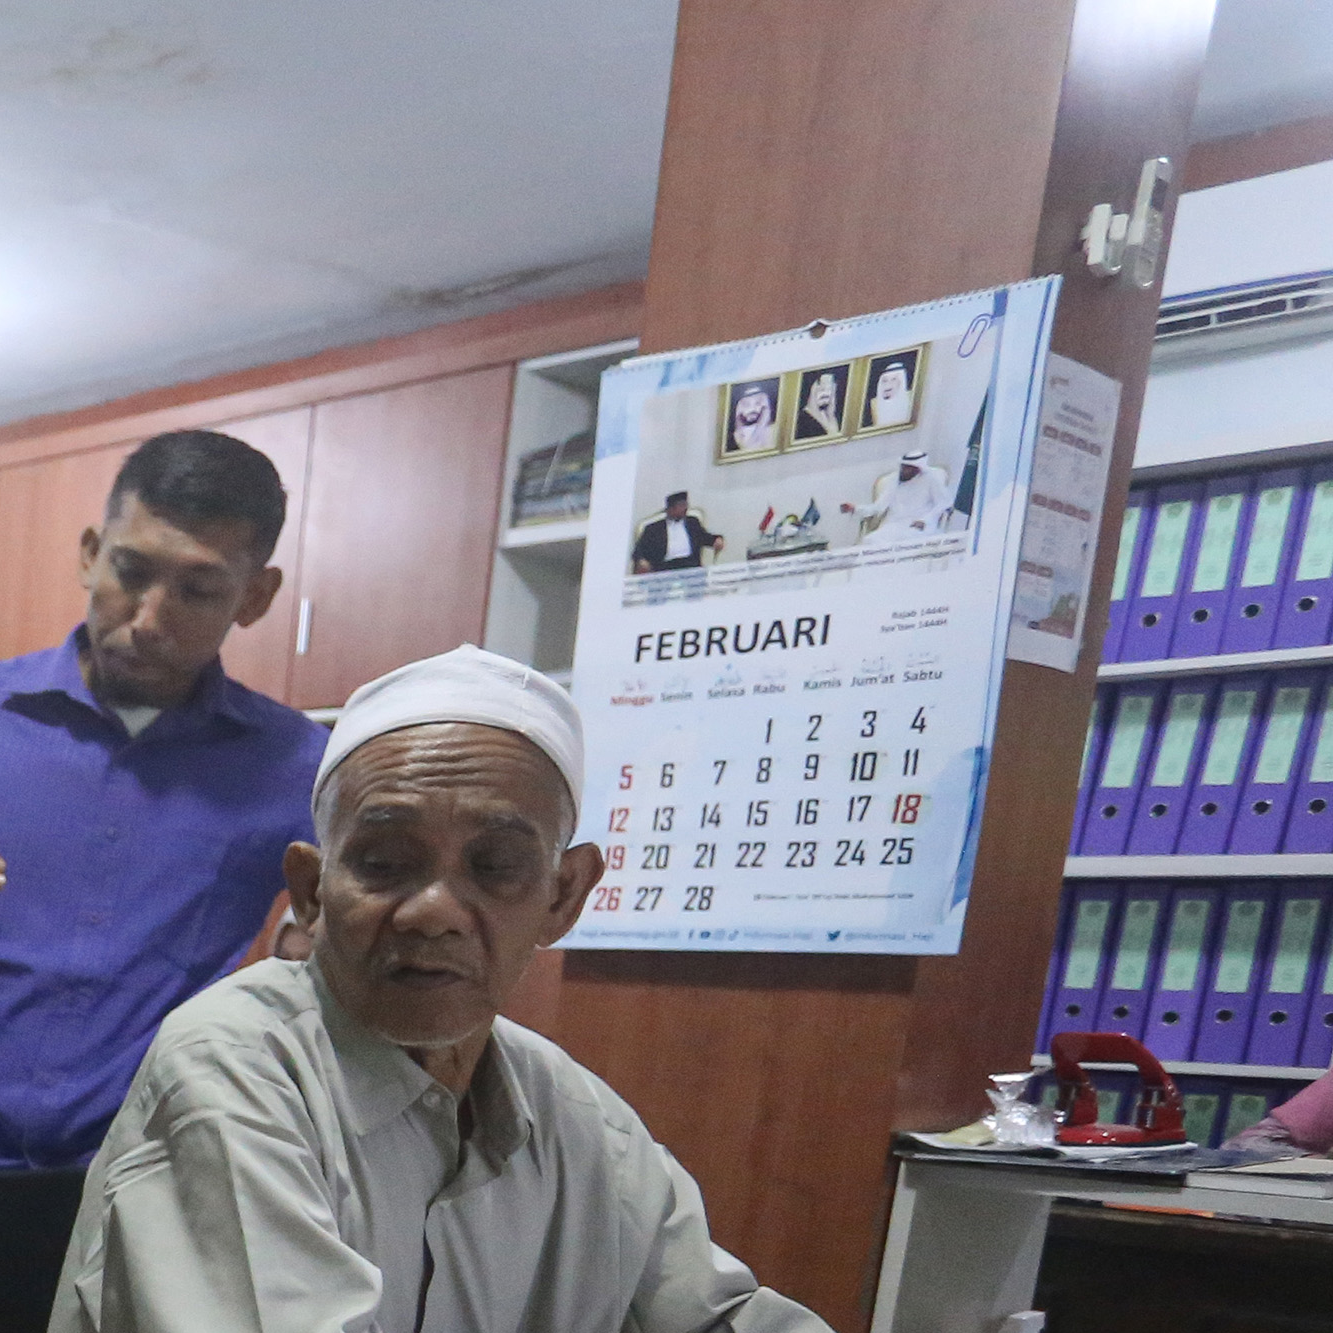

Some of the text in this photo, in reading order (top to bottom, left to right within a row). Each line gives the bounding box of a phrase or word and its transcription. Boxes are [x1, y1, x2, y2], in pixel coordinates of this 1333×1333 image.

[634, 613, 832, 663] FEBRUARI
[753, 683, 786, 694] Rabu
[803, 678, 842, 690] Kamis
[850, 673, 895, 688] Jum'at
[902, 669, 943, 683] Sabtu
[765, 706, 926, 744] 1 2 3 4
[619, 748, 920, 790] 5 6 7 8 9 10 11
[608, 793, 922, 832] 12 13 14 15 16 17 18
[605, 837, 914, 870] 19 20 21 22 23 24 25
[593, 886, 714, 911] 26 27 28
